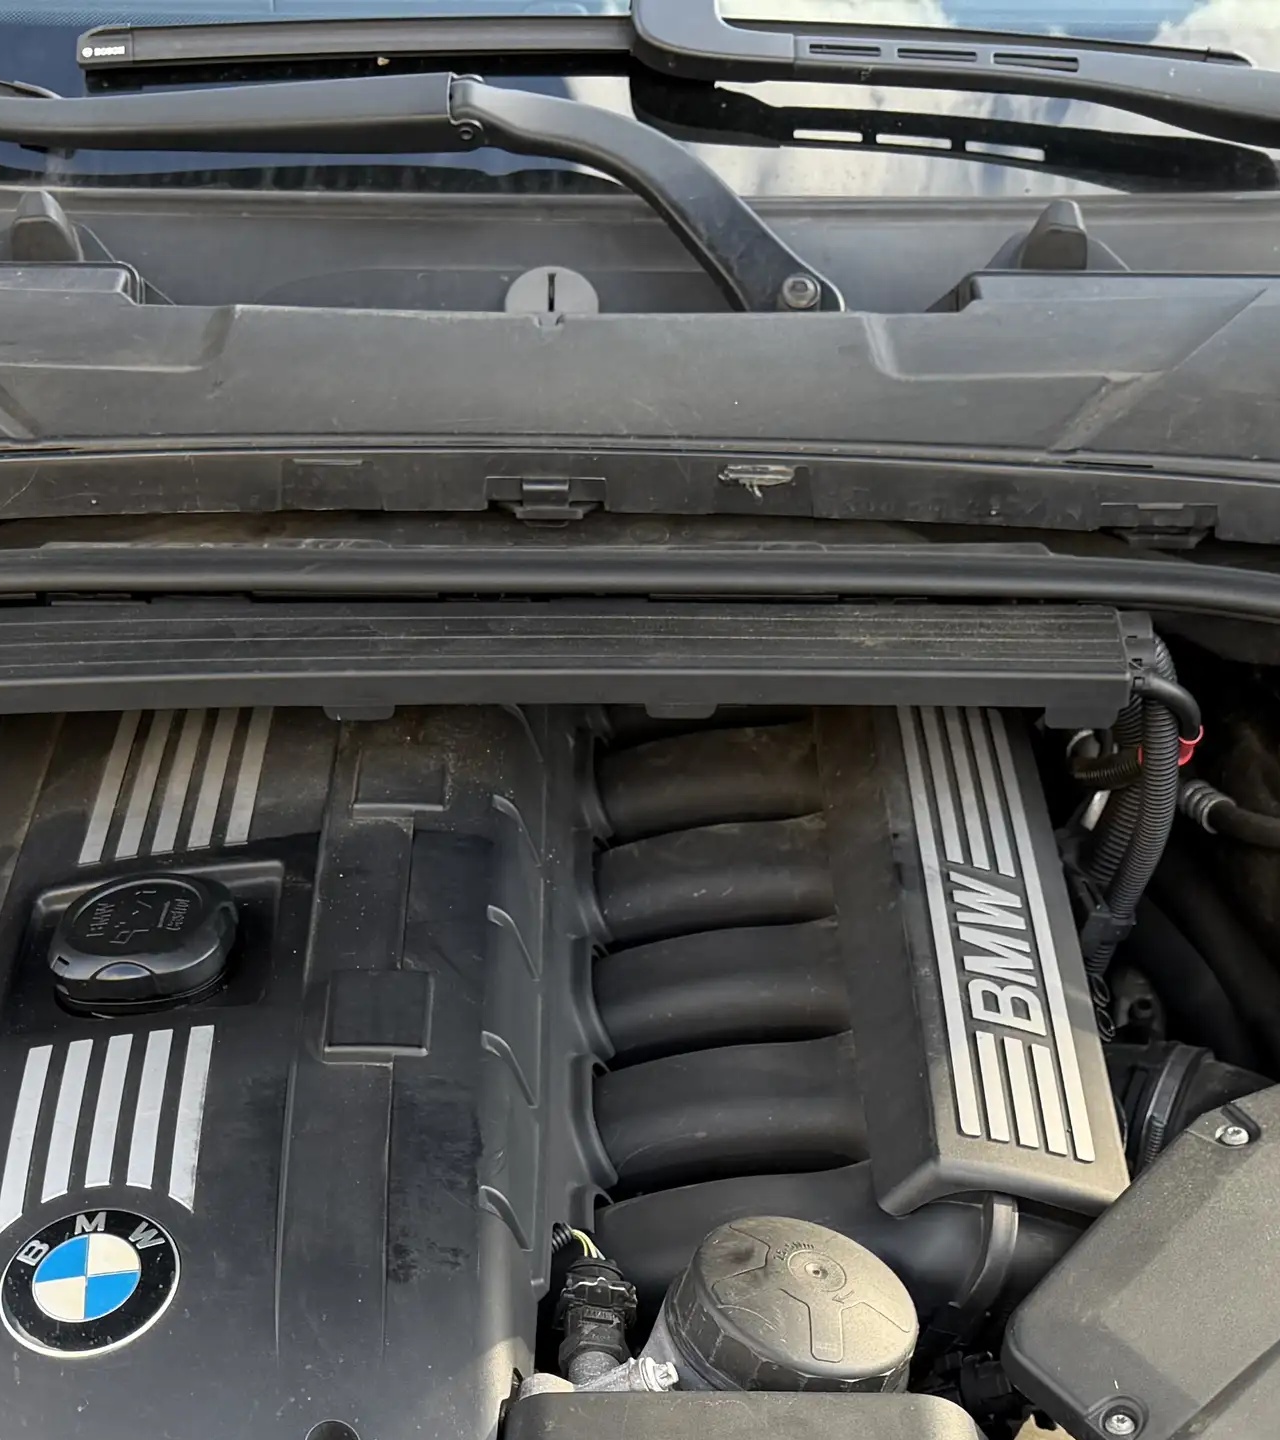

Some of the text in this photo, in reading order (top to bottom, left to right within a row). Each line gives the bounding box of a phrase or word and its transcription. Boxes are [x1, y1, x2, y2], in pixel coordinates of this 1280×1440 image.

[85, 902, 116, 938] BMW
[948, 871, 1047, 1037] BMW
[16, 1211, 166, 1267] BMW
